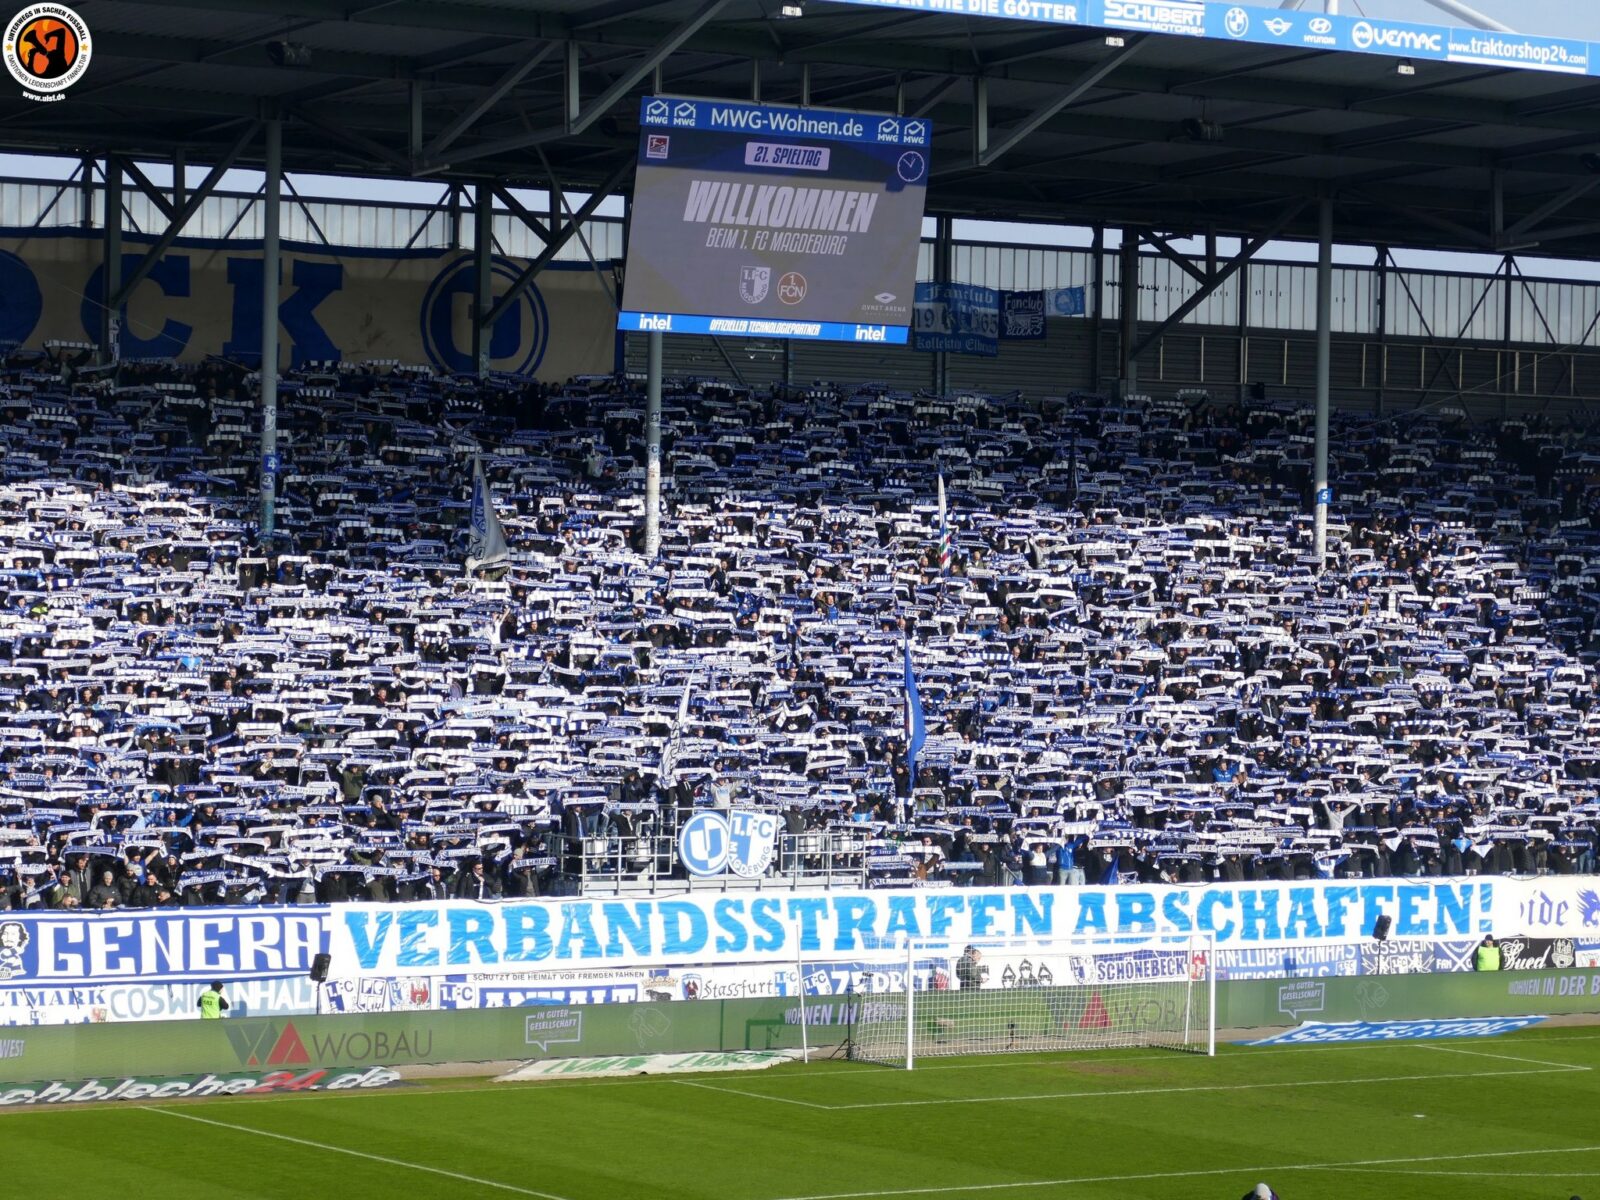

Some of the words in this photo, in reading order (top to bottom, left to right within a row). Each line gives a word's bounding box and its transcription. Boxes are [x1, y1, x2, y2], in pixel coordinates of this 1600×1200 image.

[968, 0, 998, 14] DIE
[1003, 0, 1077, 21] GÖTTER
[1104, 1, 1205, 26] SCHUBERT
[1304, 35, 1336, 45] HYUNDAI
[1448, 37, 1586, 65] www.traktorshop24.com
[646, 115, 668, 125] MWG
[673, 117, 696, 127] MWG
[711, 106, 864, 137] MWG-Wohnen.de
[877, 133, 899, 143] MWG
[903, 134, 925, 145] MWG
[754, 146, 769, 163] 21.
[772, 147, 823, 167] SPIELTAG
[682, 180, 879, 233] WILLKOMMEN
[705, 228, 738, 248] BEIM
[740, 229, 749, 249] 1.
[752, 231, 769, 251] FC
[770, 231, 848, 256] MAGDEBURG
[780, 284, 804, 298] FCN
[709, 318, 748, 332] OFFIZIELLER
[748, 320, 821, 336] TECHNOLOGIEPARTNER
[1321, 490, 1329, 500] 5
[728, 840, 771, 875] MAGDEBURG
[344, 892, 1054, 969] VERBANDSSTRAFEN
[1071, 883, 1493, 944] ABSCHAFFEN!
[512, 973, 526, 981] DIE
[578, 972, 613, 980] FREMDEN
[615, 971, 645, 979] FAHNEN
[1097, 956, 1186, 981] SCHÖNEBECK
[701, 978, 774, 1000] Stassfurt
[1543, 977, 1556, 995] IN
[1559, 975, 1587, 996] DER
[529, 1018, 578, 1031] GESELLSCHAFT
[537, 1011, 546, 1020] IN
[547, 1009, 570, 1019] GUTER
[785, 1003, 833, 1025] WOHNEN
[837, 1003, 858, 1025] IN
[311, 1029, 433, 1061] WOBAU
